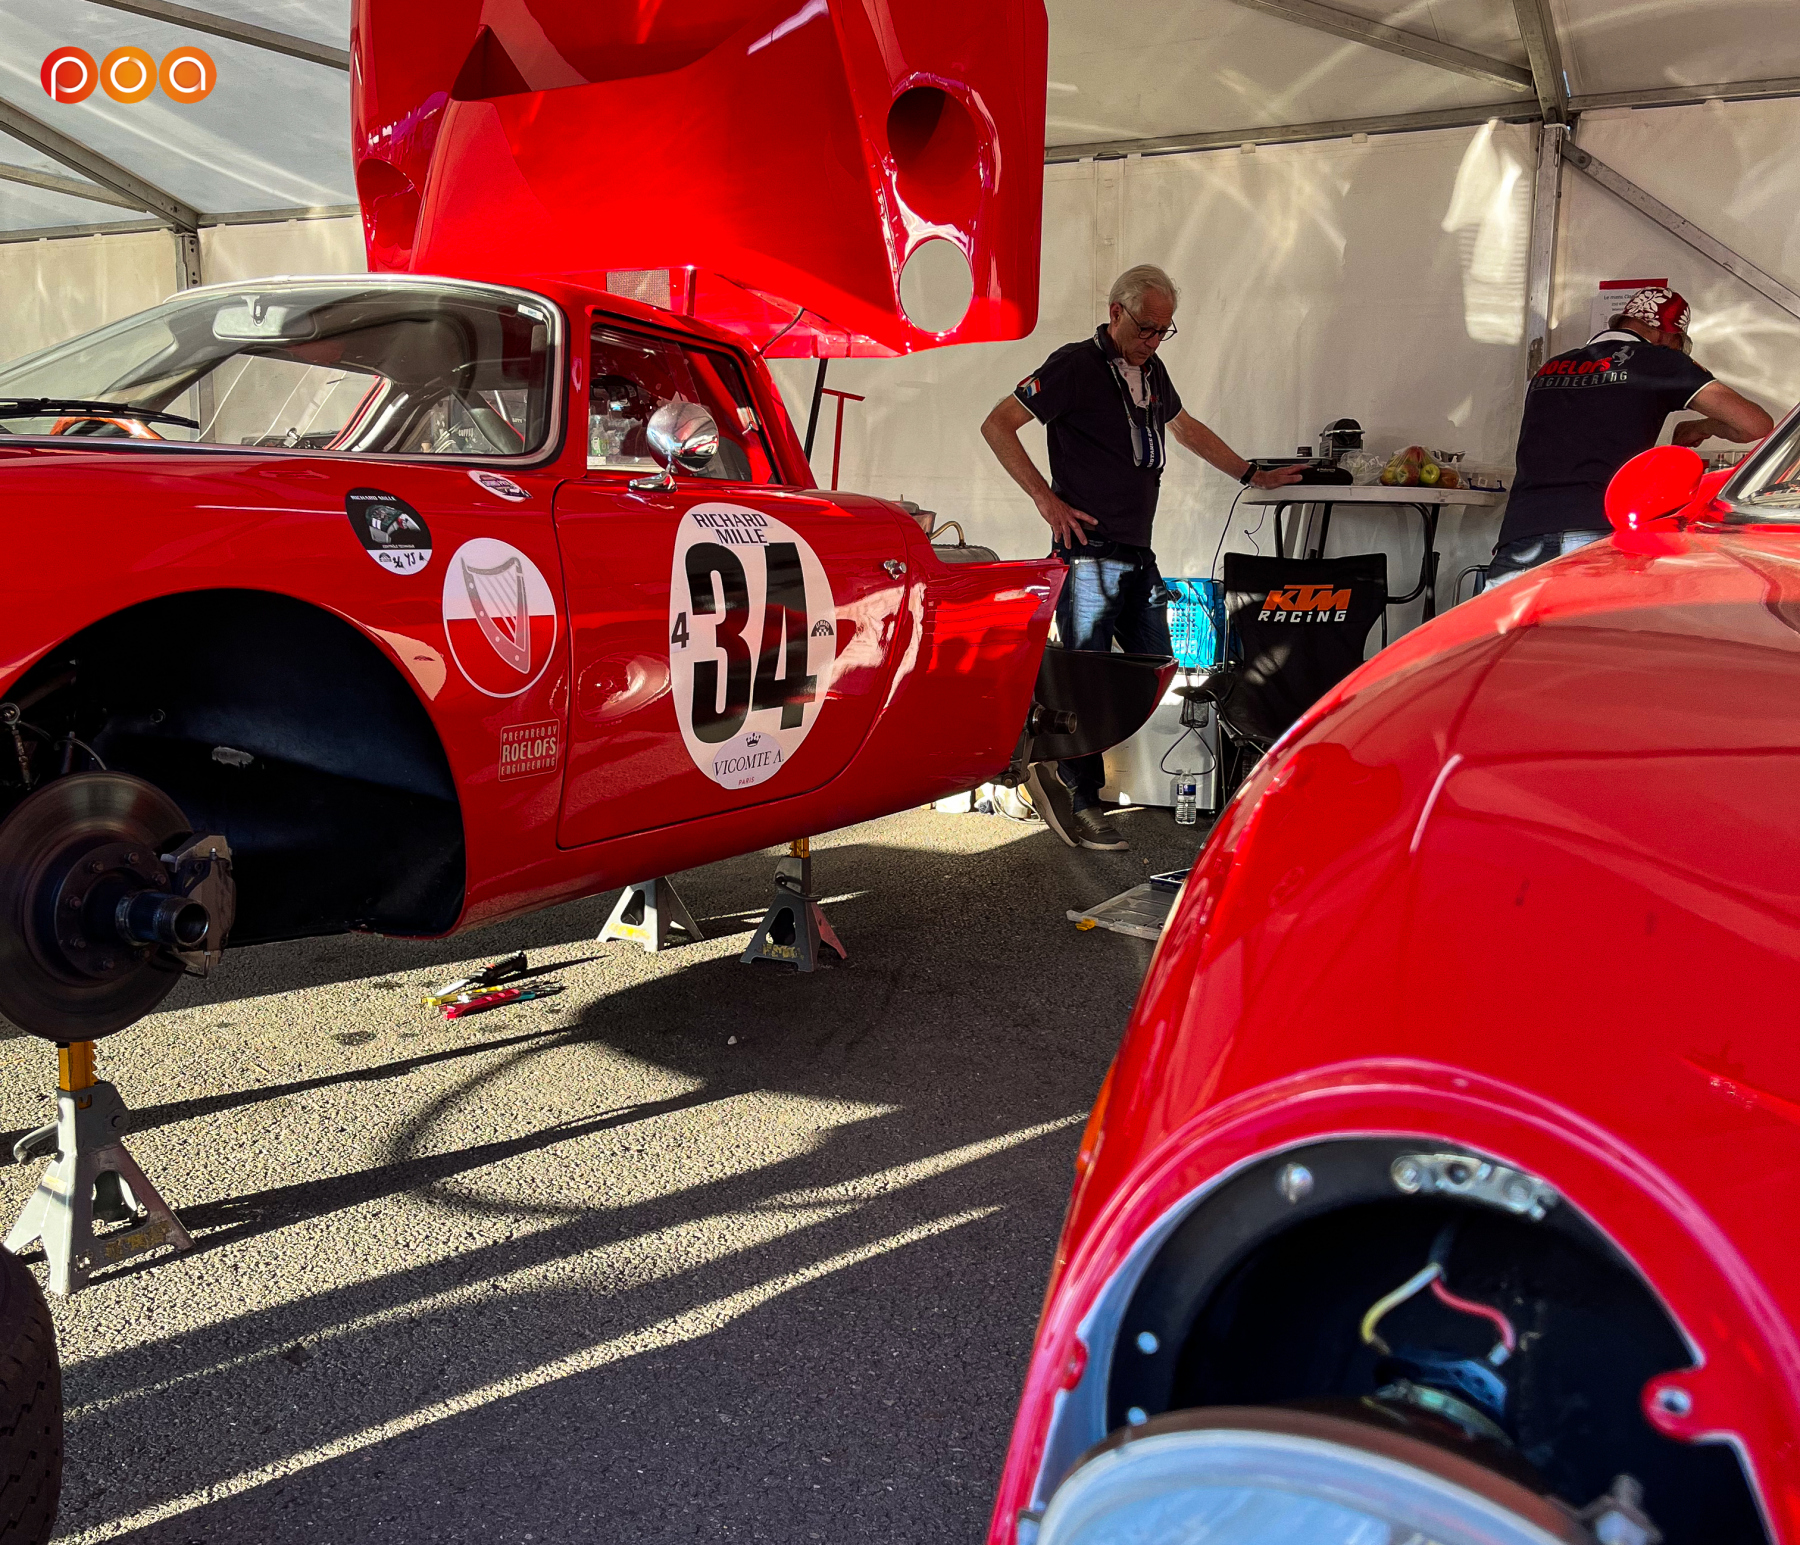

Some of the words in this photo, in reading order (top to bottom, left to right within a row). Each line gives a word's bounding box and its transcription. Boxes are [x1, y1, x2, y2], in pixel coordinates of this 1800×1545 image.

[692, 513, 768, 528] RICHARD
[715, 528, 768, 544] MILLE
[1262, 584, 1352, 611] KTM
[671, 611, 690, 648] 4
[684, 541, 818, 744] 34
[503, 726, 545, 742] PREPARED
[547, 725, 557, 735] BY
[502, 737, 556, 763] ROELOFS
[501, 757, 555, 775] ENGINEERING
[714, 751, 769, 777] VICOMTE
[738, 777, 755, 786] PARIS
